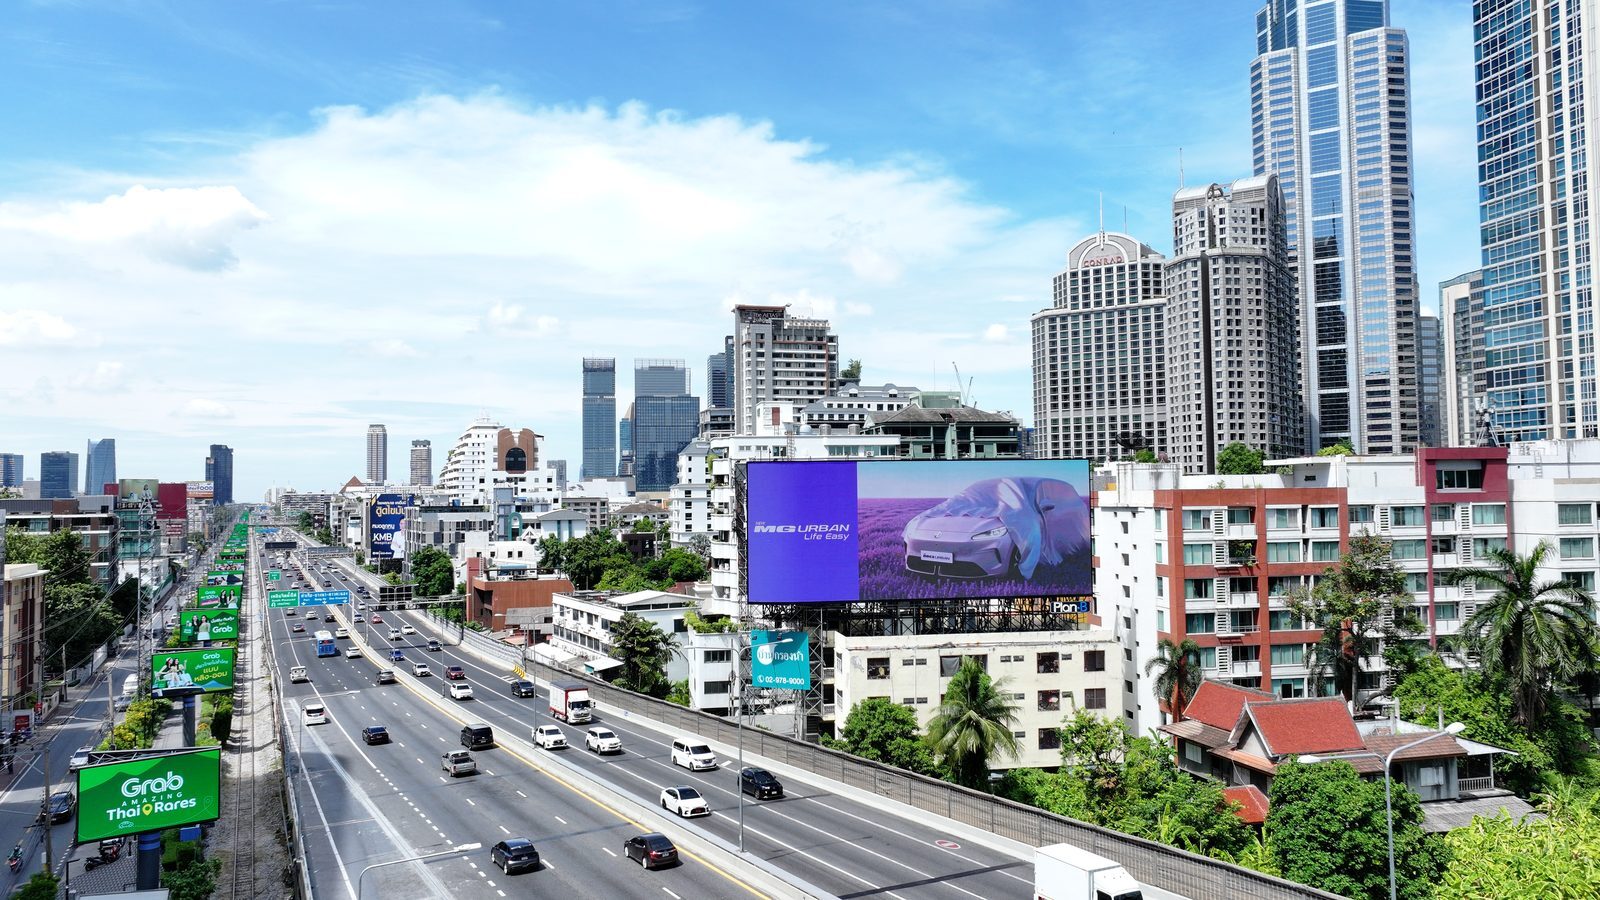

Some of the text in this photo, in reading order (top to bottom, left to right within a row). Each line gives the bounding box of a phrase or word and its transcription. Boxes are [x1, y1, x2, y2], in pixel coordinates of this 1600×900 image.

[1083, 256, 1123, 267] CONRAD
[797, 524, 850, 533] URBAN
[372, 533, 393, 542] KMB
[804, 533, 850, 541] Life Easy
[212, 625, 233, 633] Grab
[202, 652, 221, 660] Grab
[121, 771, 184, 798] Grab
[121, 792, 183, 807] AMAZING
[106, 798, 197, 821] Thai Rares
